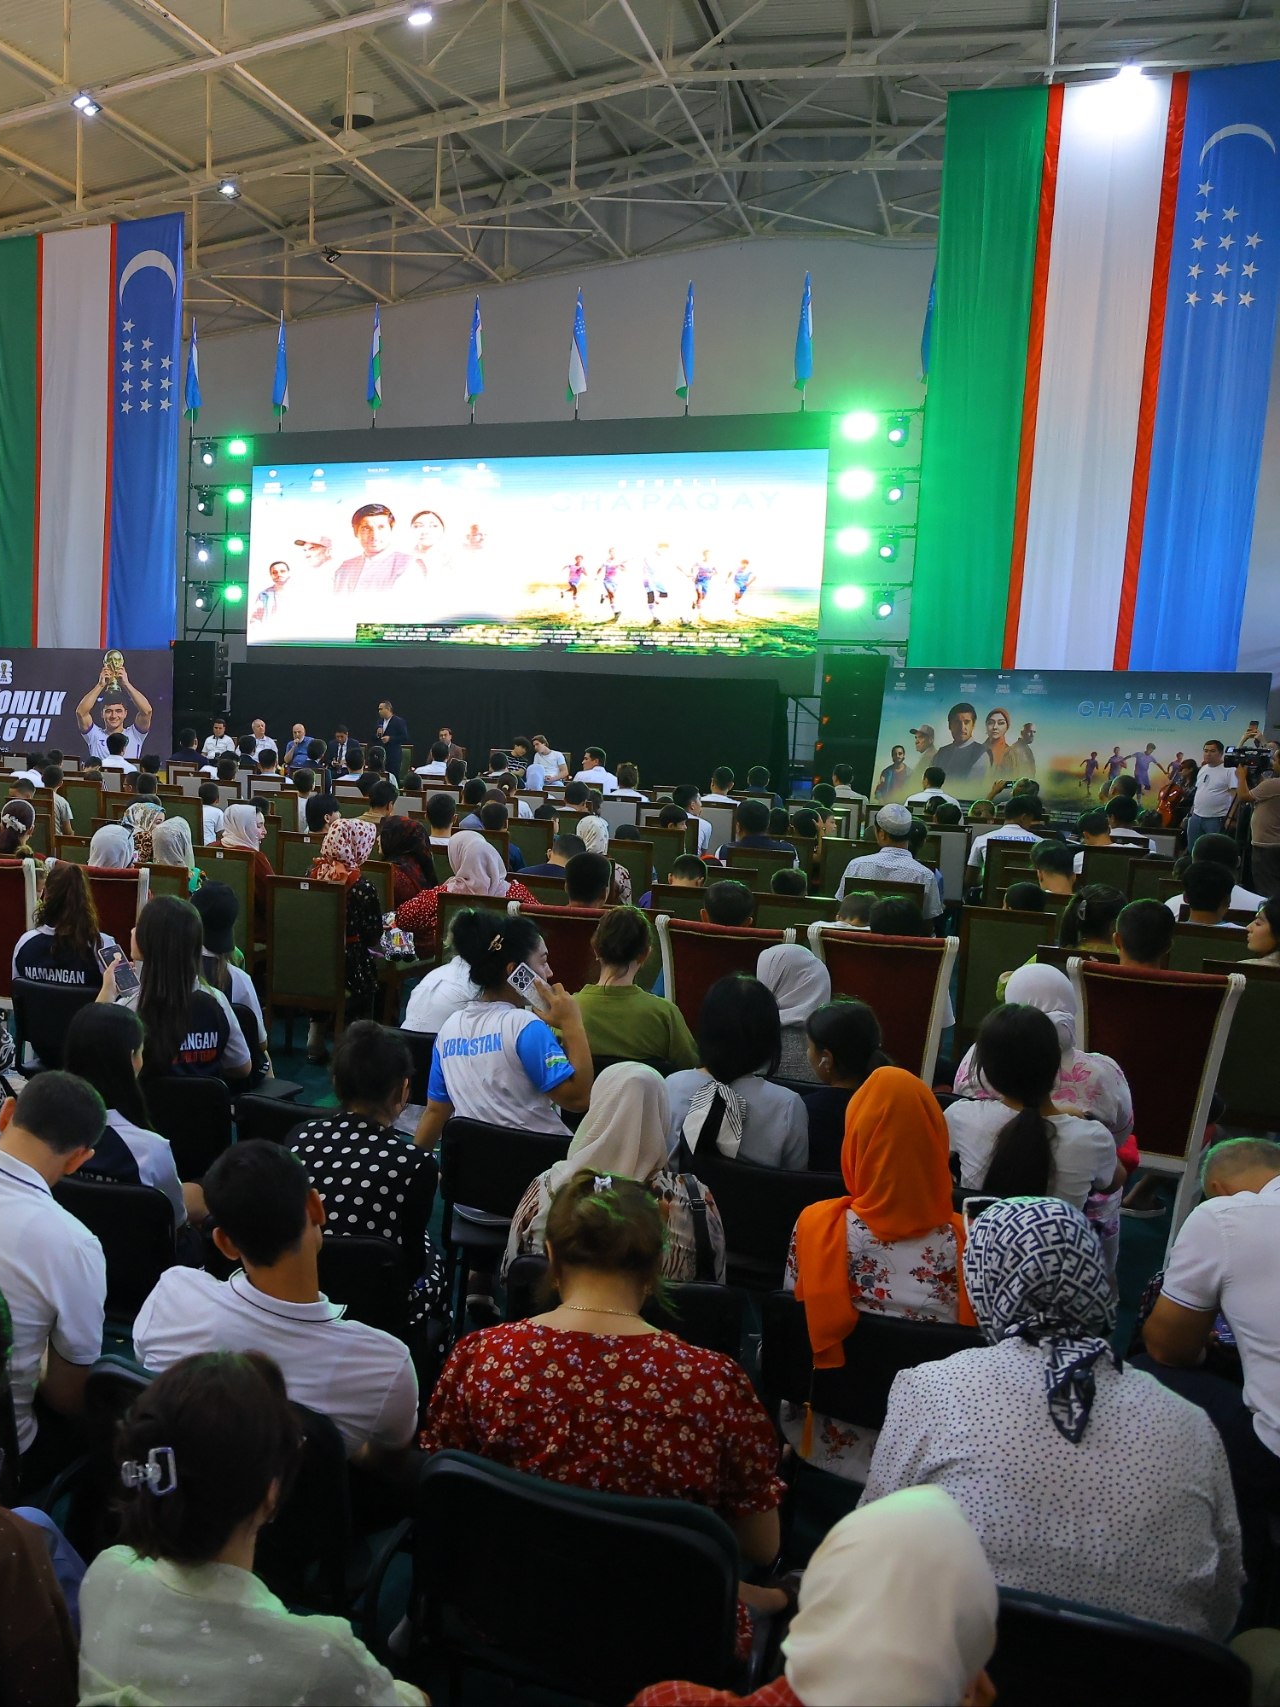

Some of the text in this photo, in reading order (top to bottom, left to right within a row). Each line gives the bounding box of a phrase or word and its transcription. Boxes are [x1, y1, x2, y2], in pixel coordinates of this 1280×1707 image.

[1077, 701, 1237, 722] CHAPAQAY
[24, 966, 85, 985] NAMANGAN
[180, 1031, 218, 1051] ANGAN
